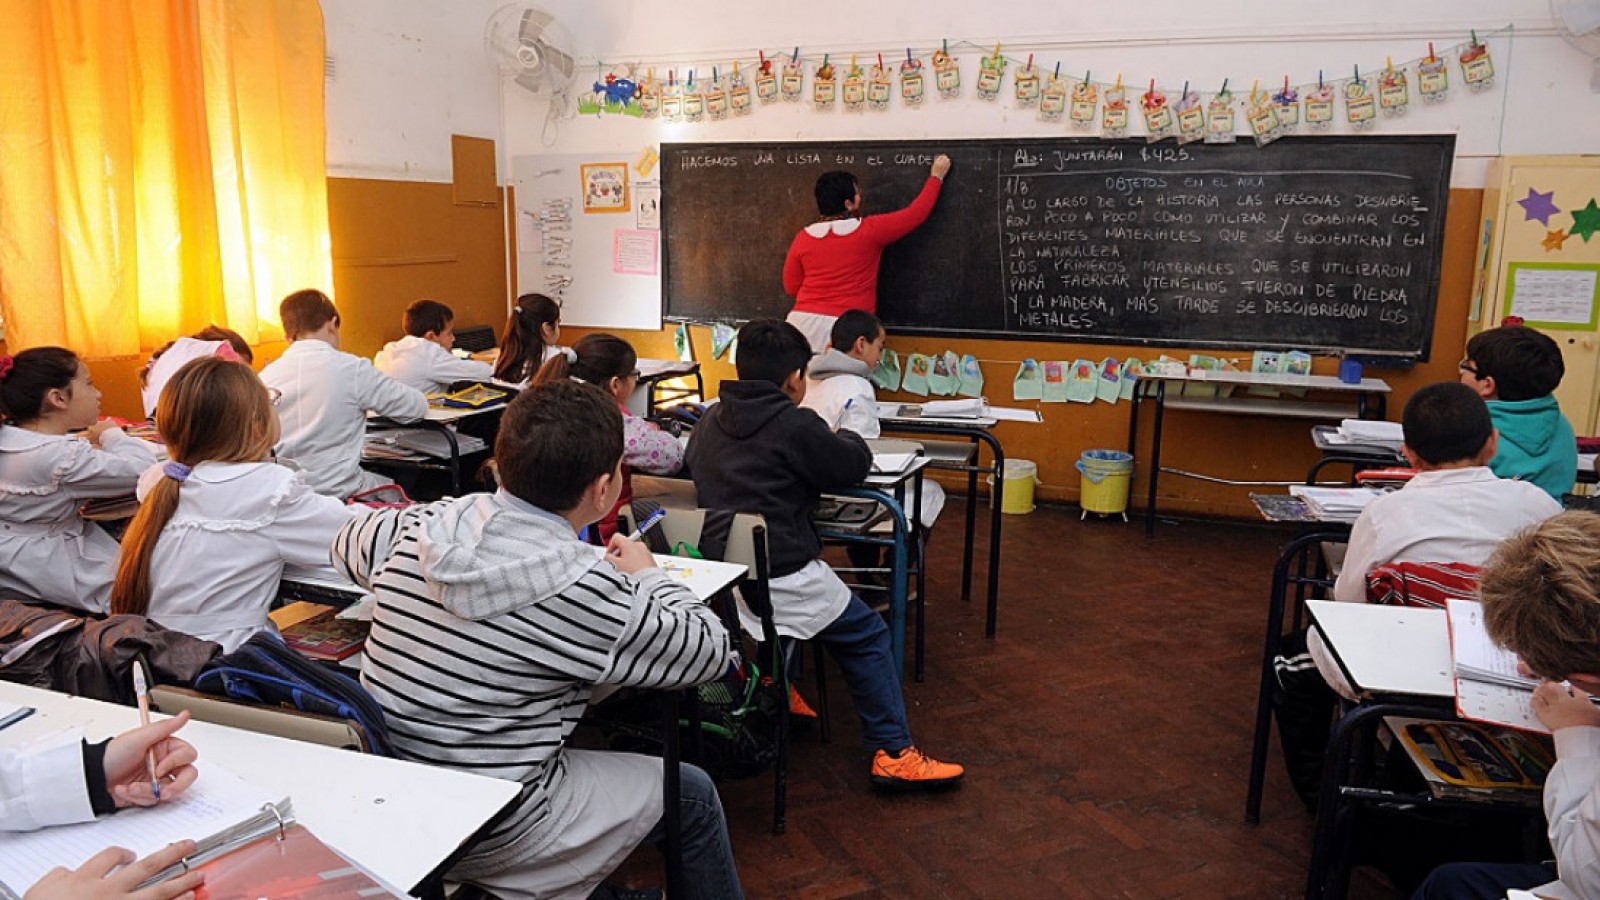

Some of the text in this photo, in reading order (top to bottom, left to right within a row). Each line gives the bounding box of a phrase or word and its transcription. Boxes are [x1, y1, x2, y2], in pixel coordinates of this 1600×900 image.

[681, 156, 738, 170] HACEMOS
[754, 153, 774, 166] UNA
[786, 153, 821, 165] LISTA
[836, 155, 854, 165] EN
[867, 155, 884, 166] EL
[1105, 177, 1167, 195] OBJETOS
[1184, 178, 1203, 188] EN
[1212, 178, 1227, 188] EL
[1005, 199, 1014, 212] A
[1022, 199, 1037, 210] LO
[1046, 196, 1088, 209] LARGO
[1128, 197, 1144, 207] LA
[1156, 194, 1219, 207] HISTORIA
[1237, 194, 1263, 207] LAS
[1275, 194, 1341, 207] PERSONAS
[1006, 215, 1031, 228] RON
[1044, 211, 1077, 224] POCO
[1085, 211, 1094, 222] A
[1102, 211, 1137, 223] POCO
[1154, 211, 1192, 223] COMO
[1204, 213, 1267, 225] UTILIZAR
[1302, 213, 1378, 226] COMBINAR
[1392, 213, 1420, 226] LOS
[1006, 230, 1088, 244] DIFERENTES
[1105, 227, 1201, 243] MATERIALES
[1219, 229, 1247, 243] QUE
[1294, 232, 1392, 249] ENCUENTRAN
[1403, 233, 1425, 247] EN
[1010, 246, 1025, 258] LA
[1010, 258, 1412, 278] LOS PRIMEROS MATERIALES QUE SE UTILIZARON
[1010, 274, 1408, 305] PARA FABRICAR UTENSILIOS FUERON DE PIEDRA
[1028, 295, 1044, 310] LA
[1175, 295, 1219, 315] TARDE
[1236, 301, 1256, 314] SE
[1265, 301, 1368, 320] DESCUBRIERON
[1380, 307, 1408, 324] LOS
